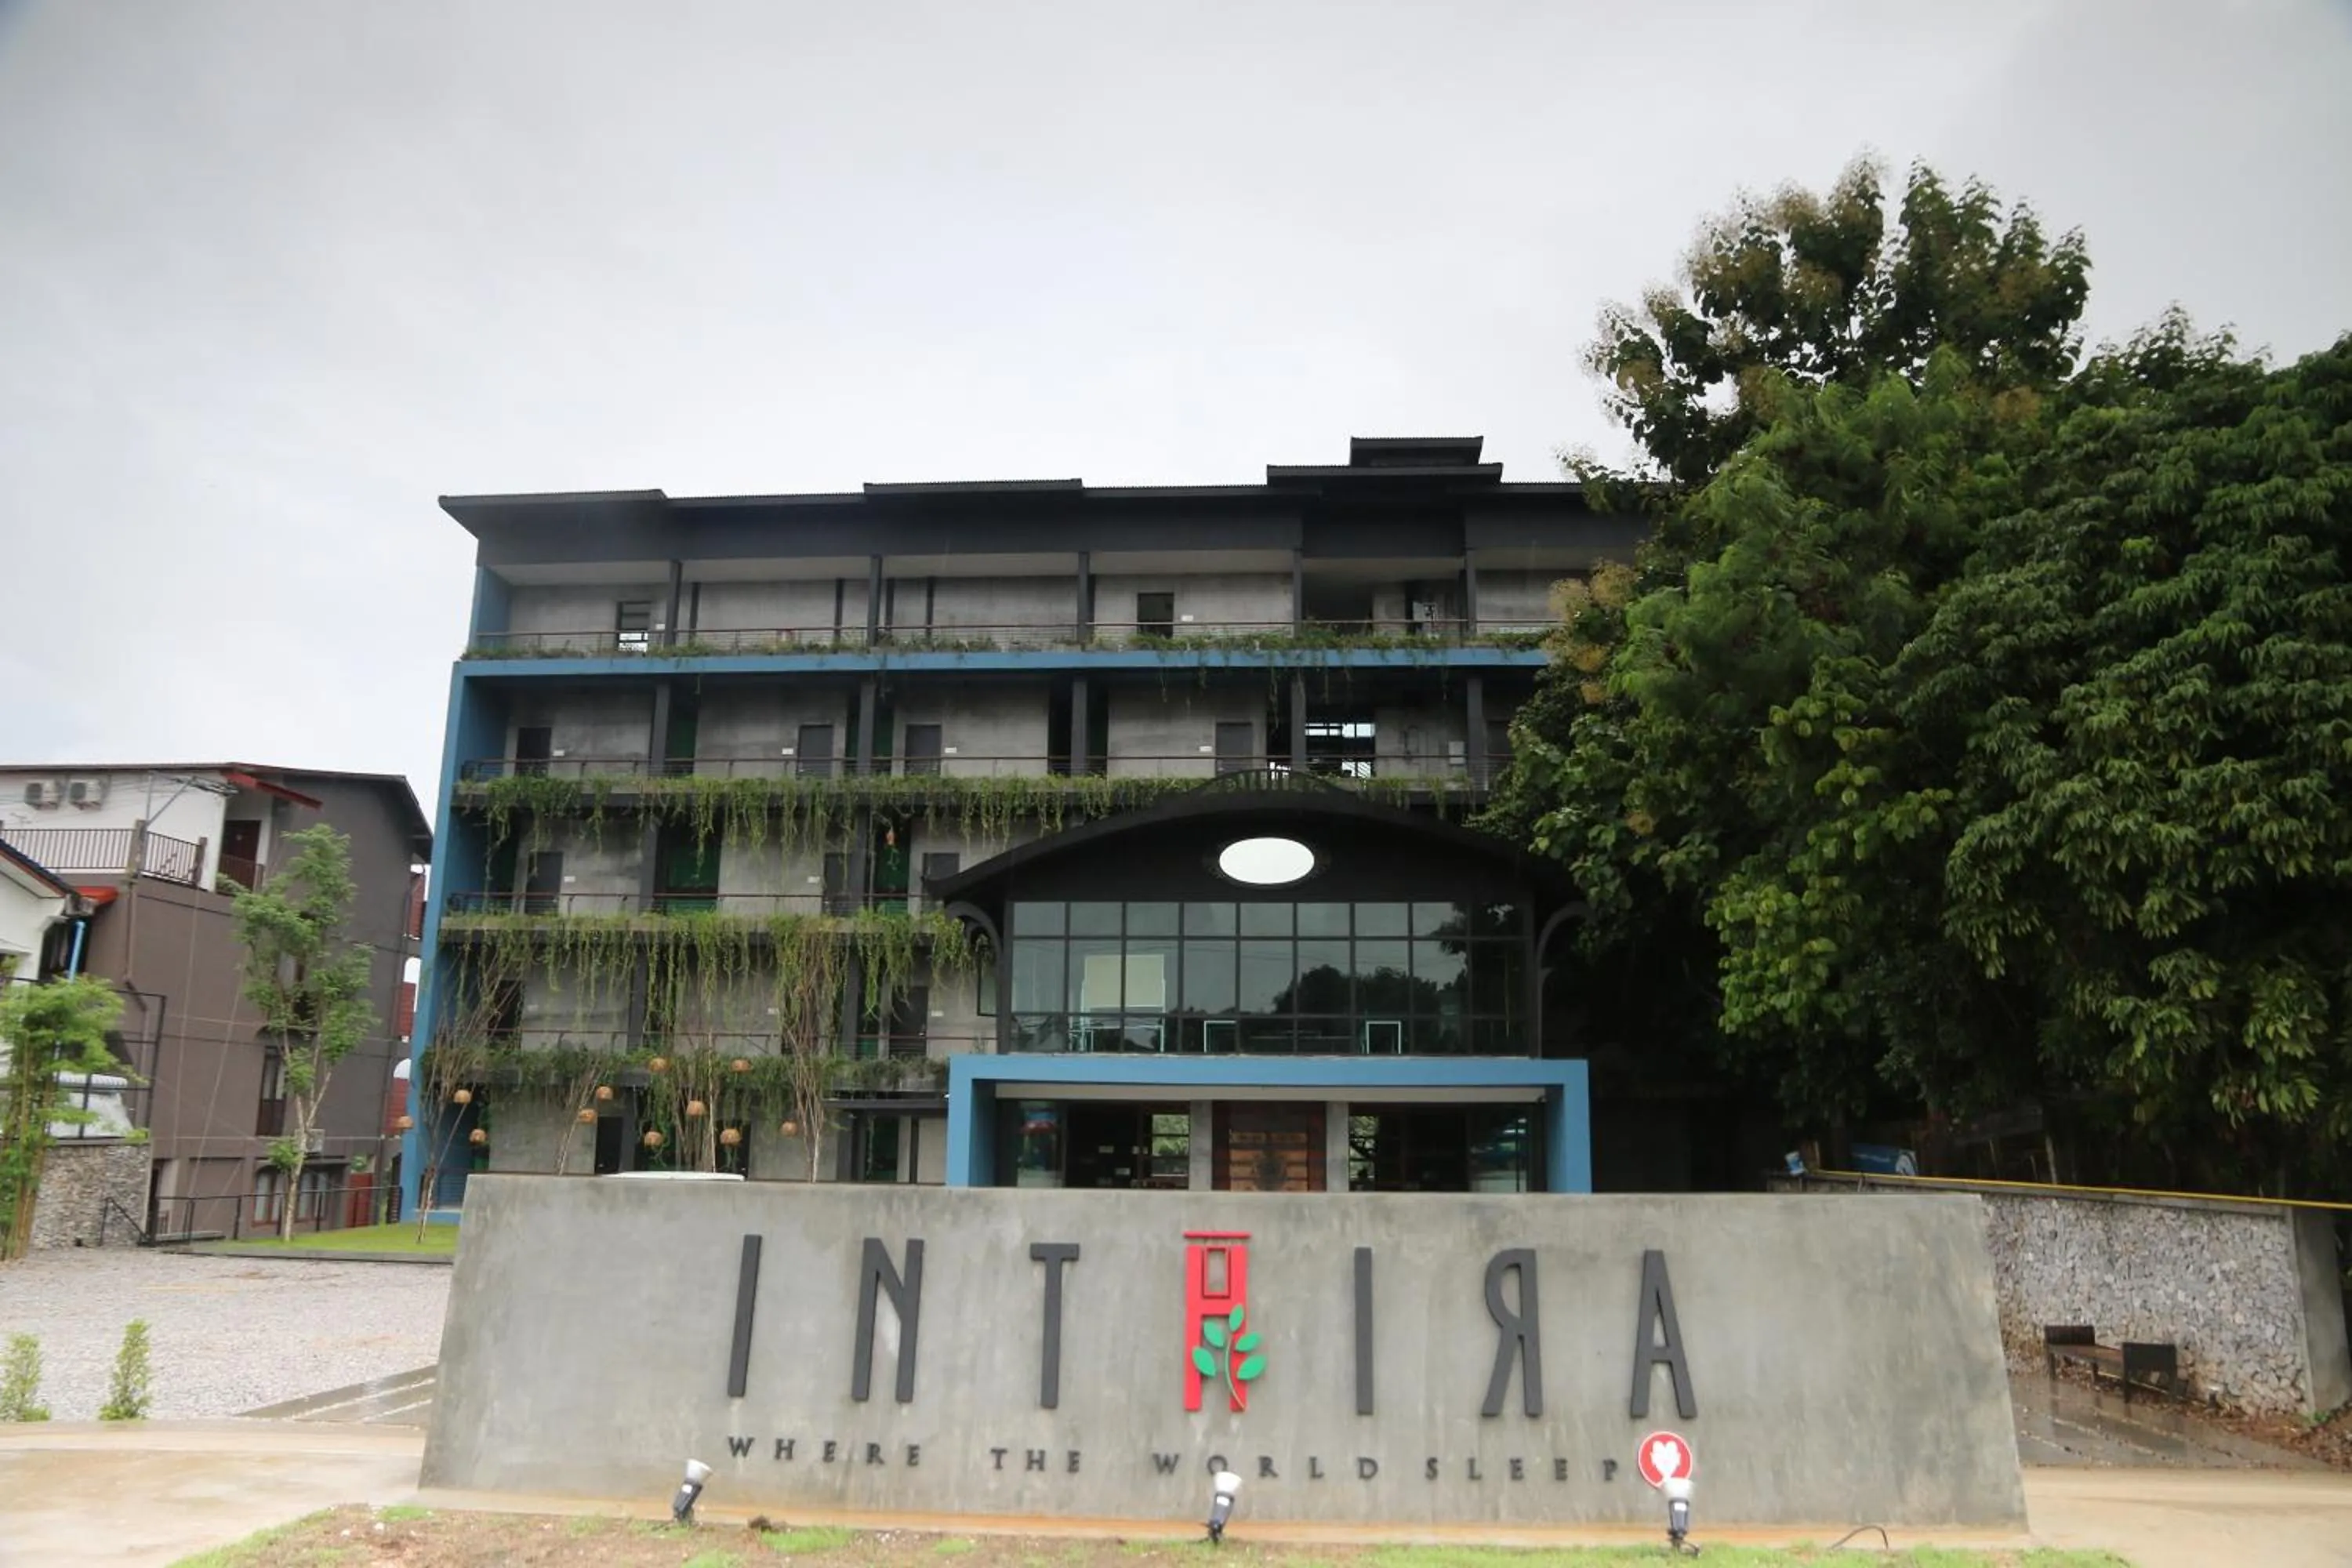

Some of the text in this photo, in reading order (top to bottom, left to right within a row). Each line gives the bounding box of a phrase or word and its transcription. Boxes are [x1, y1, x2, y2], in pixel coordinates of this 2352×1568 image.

[728, 1436, 1618, 1481] WHERE THE WORLD SLEEP
